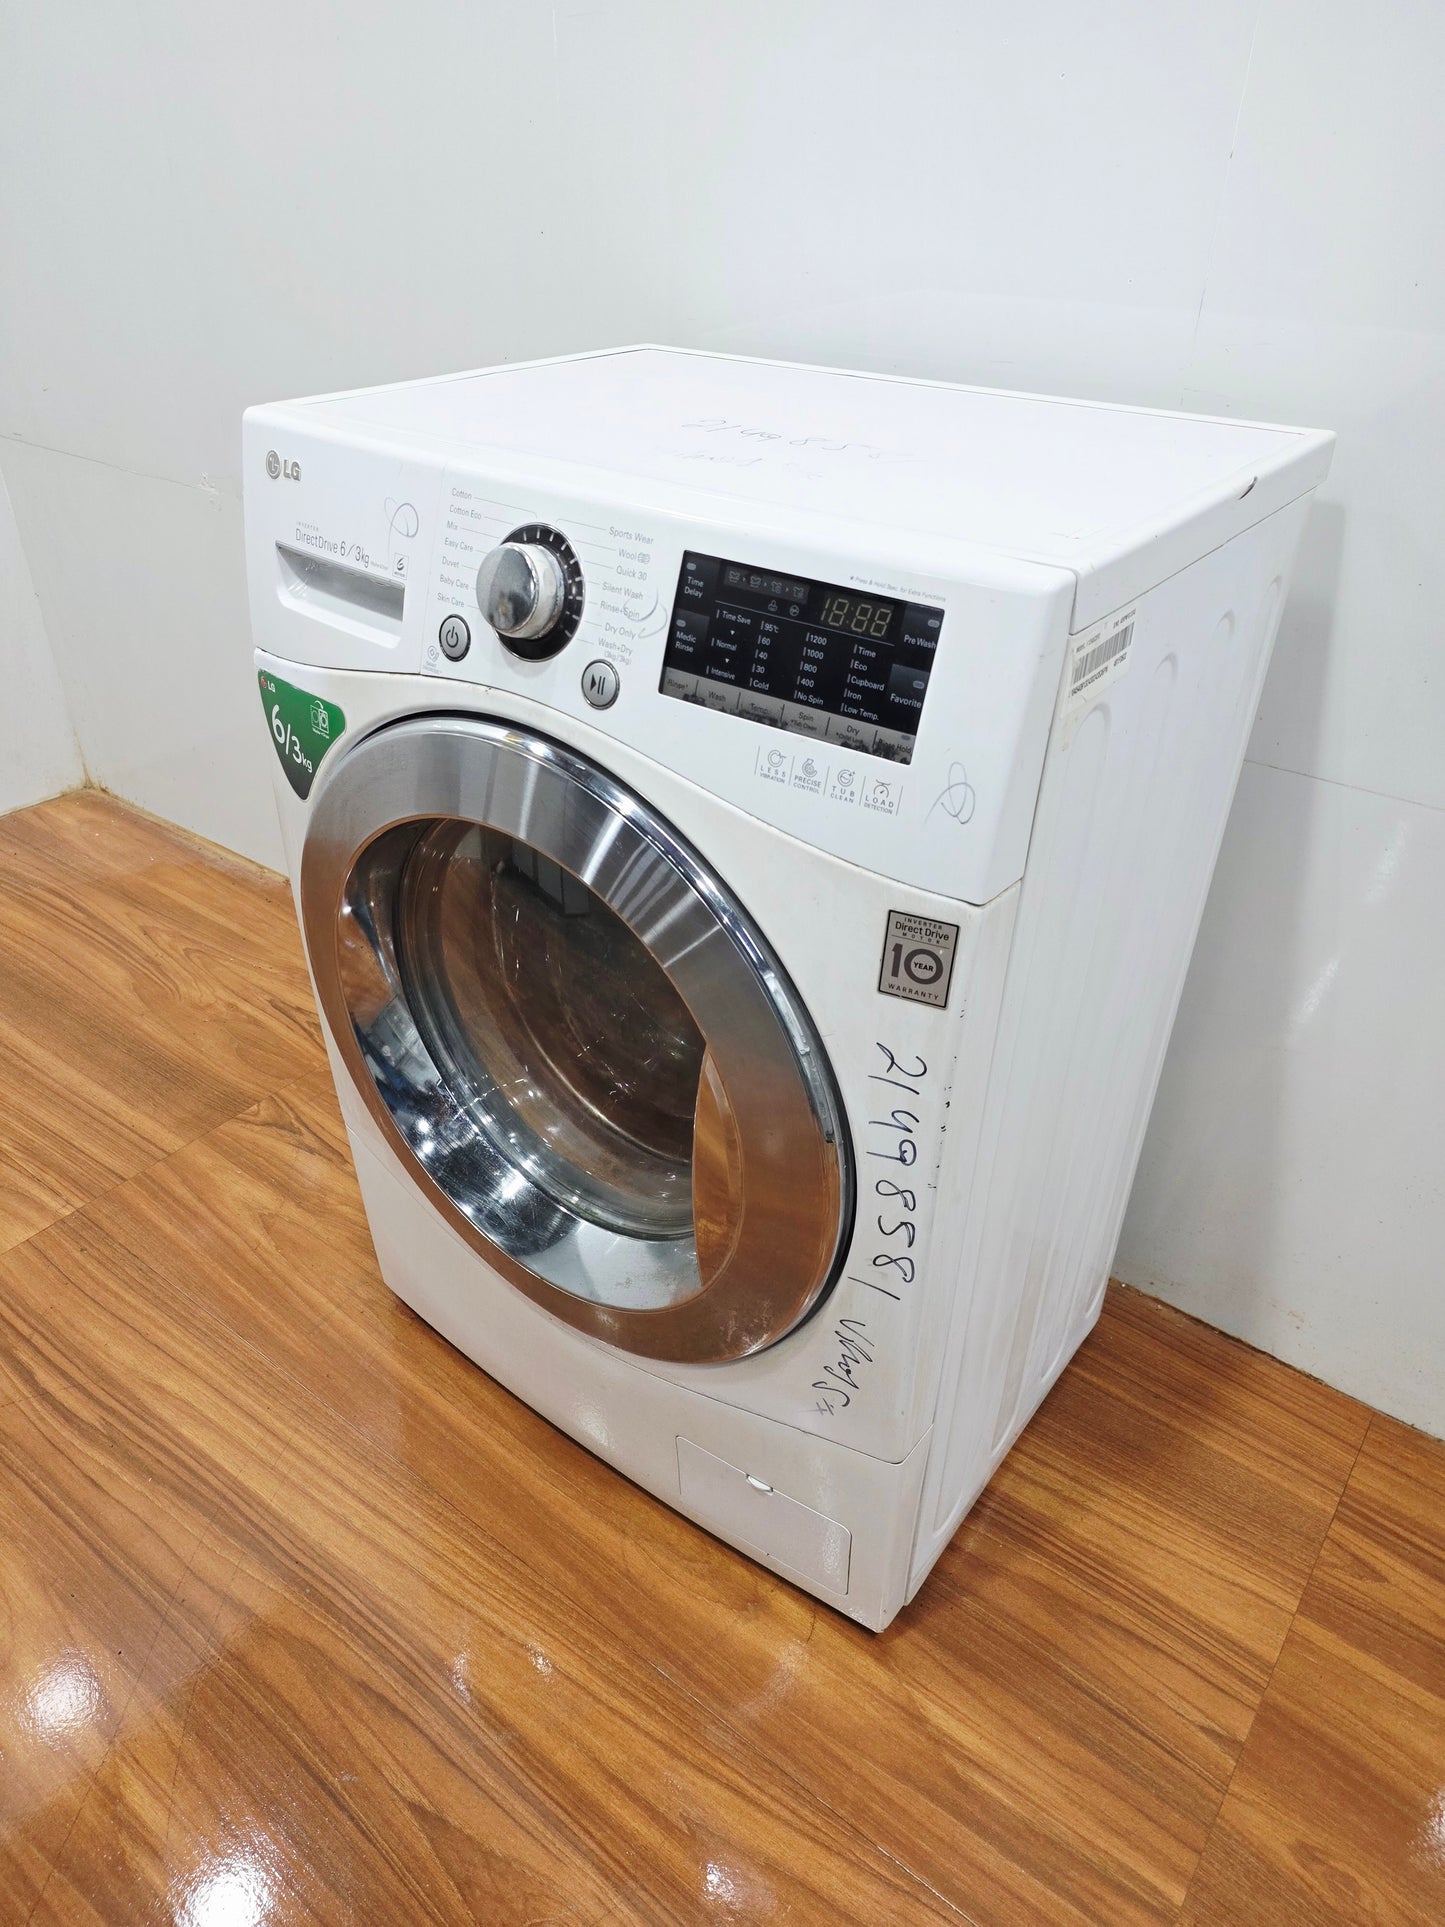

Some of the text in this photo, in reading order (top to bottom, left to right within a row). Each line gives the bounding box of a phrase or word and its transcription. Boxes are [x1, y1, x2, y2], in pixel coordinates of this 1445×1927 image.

[283, 459, 301, 481] LG
[451, 487, 472, 500] Cotton
[449, 504, 482, 520] Cotton Eco
[446, 520, 458, 531] Mix
[608, 526, 654, 545] Sports Wear
[444, 537, 474, 552] Easy Care
[618, 548, 637, 561] Wool
[441, 555, 460, 569] Duvet
[616, 565, 648, 581] Quick 30
[439, 573, 469, 590] Baby Care
[687, 576, 704, 588] Time
[601, 581, 644, 599] Silent Wash
[684, 586, 703, 599] Delay
[907, 588, 921, 597] Extra
[921, 591, 946, 602] Functions
[437, 592, 465, 608] Skin Care
[600, 600, 640, 619] Rinse+Spin
[722, 610, 752, 626] Time Save
[604, 622, 637, 640] Dry Only
[676, 631, 697, 643] Medic
[597, 637, 633, 656] Wash+Dry
[716, 640, 737, 651] Normal
[761, 637, 771, 646] 60
[810, 635, 827, 645] 1200
[904, 634, 937, 649] Pre Wash
[675, 642, 694, 653] Rinse
[807, 649, 824, 659] 1000
[858, 646, 877, 658] Time
[758, 651, 768, 660] 40
[755, 665, 765, 674] 30
[803, 663, 817, 673] 800
[854, 661, 868, 671] Eco
[711, 667, 736, 680] Intensive
[753, 680, 770, 690] Cold
[801, 678, 814, 687] 400
[851, 676, 885, 691] Cupboard
[708, 690, 726, 701] Wash
[798, 691, 823, 706] No Spin
[847, 691, 862, 700] Iron
[890, 693, 922, 709] Favorite
[798, 711, 814, 722] Spin
[844, 704, 879, 720] Low Temp.
[846, 724, 860, 736] Dry
[896, 742, 912, 754] Hold
[760, 765, 786, 777] LESS
[759, 772, 785, 784] VIBRATION
[794, 775, 822, 788] PRECISE
[793, 782, 820, 794] CONTROL
[832, 785, 855, 798] TUB
[830, 793, 854, 804] CLEAN
[865, 795, 894, 808] LOAD
[864, 802, 893, 815] DETECTION
[904, 917, 942, 930] INVERTER
[895, 921, 949, 941] Direct Drive
[902, 932, 940, 944] MOTOR
[891, 943, 943, 985] 10
[914, 961, 934, 972] YEAR
[888, 983, 939, 1000] WARRANTY
